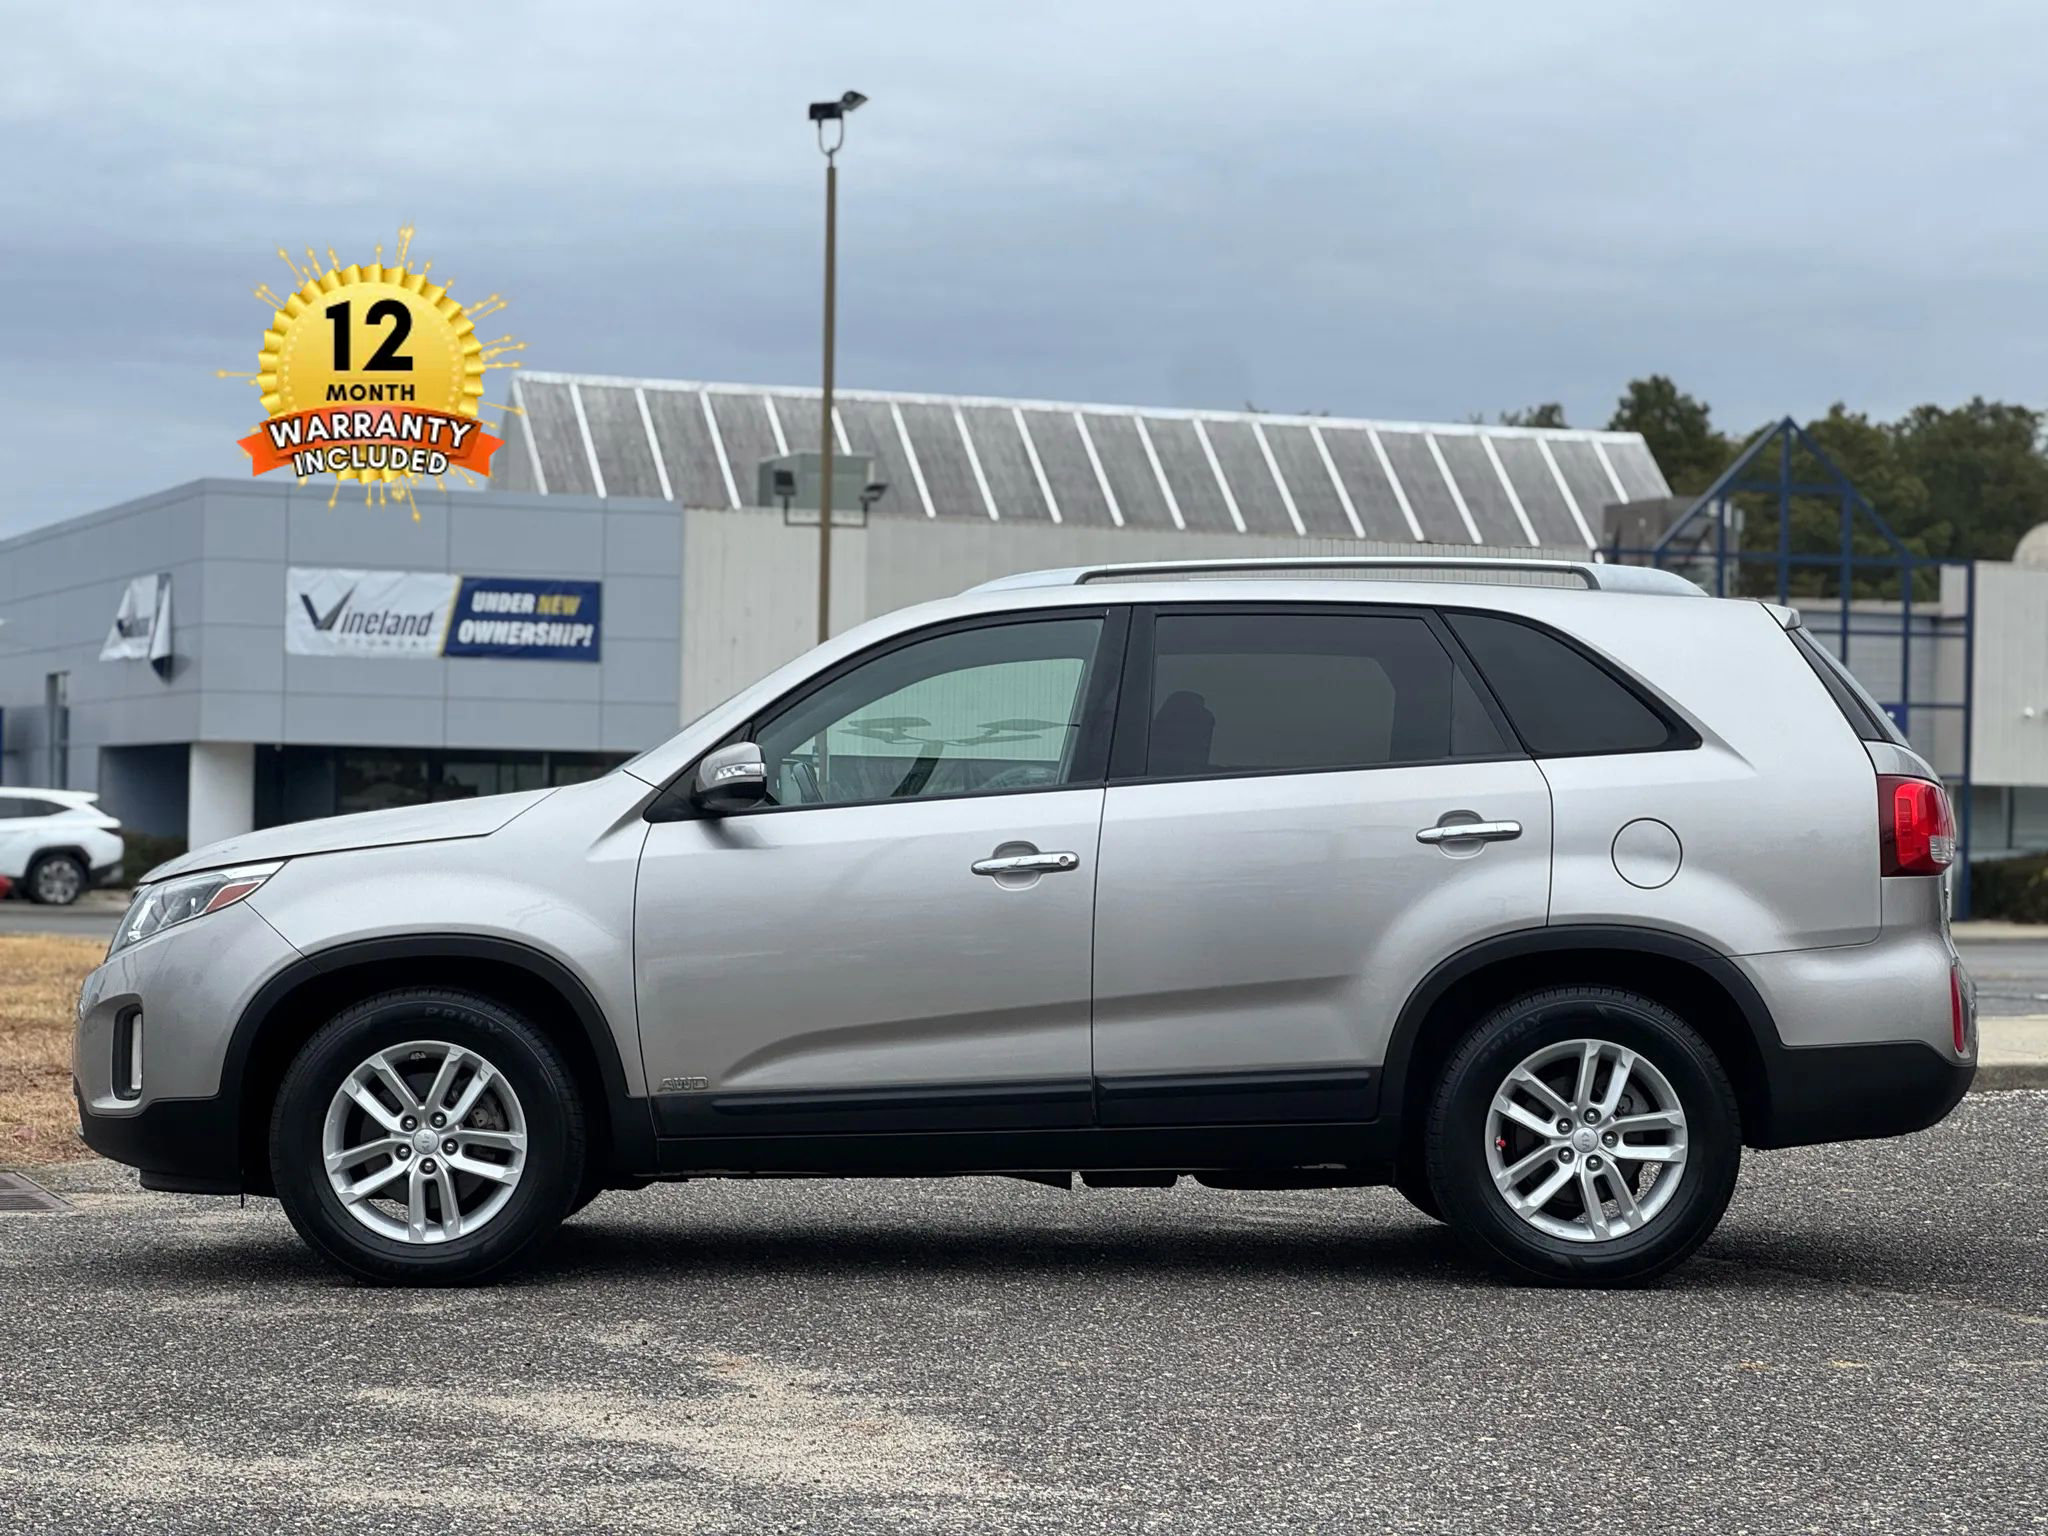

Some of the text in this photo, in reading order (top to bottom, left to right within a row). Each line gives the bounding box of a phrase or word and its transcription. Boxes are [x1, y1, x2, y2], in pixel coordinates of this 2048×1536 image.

[301, 583, 434, 636] Vineland
[471, 591, 581, 616] UNDER NEW
[457, 619, 594, 647] OWNERSHIP!
[657, 1076, 709, 1093] AWD
